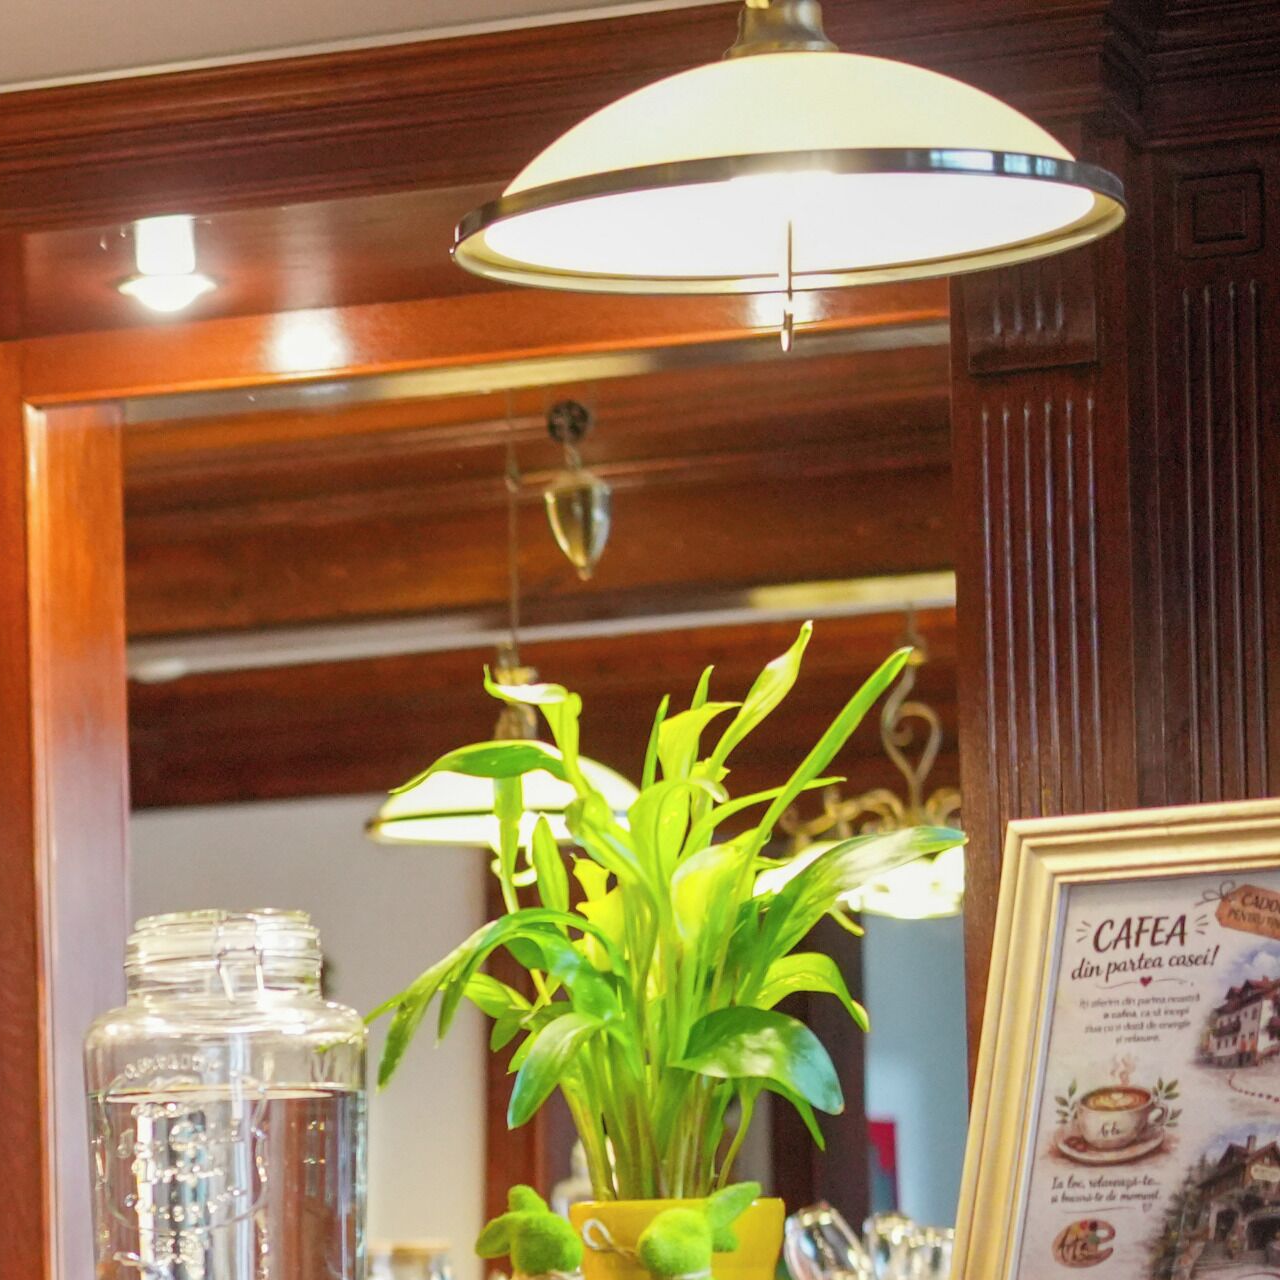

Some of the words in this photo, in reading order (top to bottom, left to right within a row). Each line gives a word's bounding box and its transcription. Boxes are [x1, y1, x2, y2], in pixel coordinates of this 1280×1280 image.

[1241, 893, 1280, 914] CADO
[1093, 914, 1187, 953] CAFEA
[1071, 957, 1101, 980] din
[1105, 953, 1163, 983] partea
[1168, 944, 1220, 967] casei!
